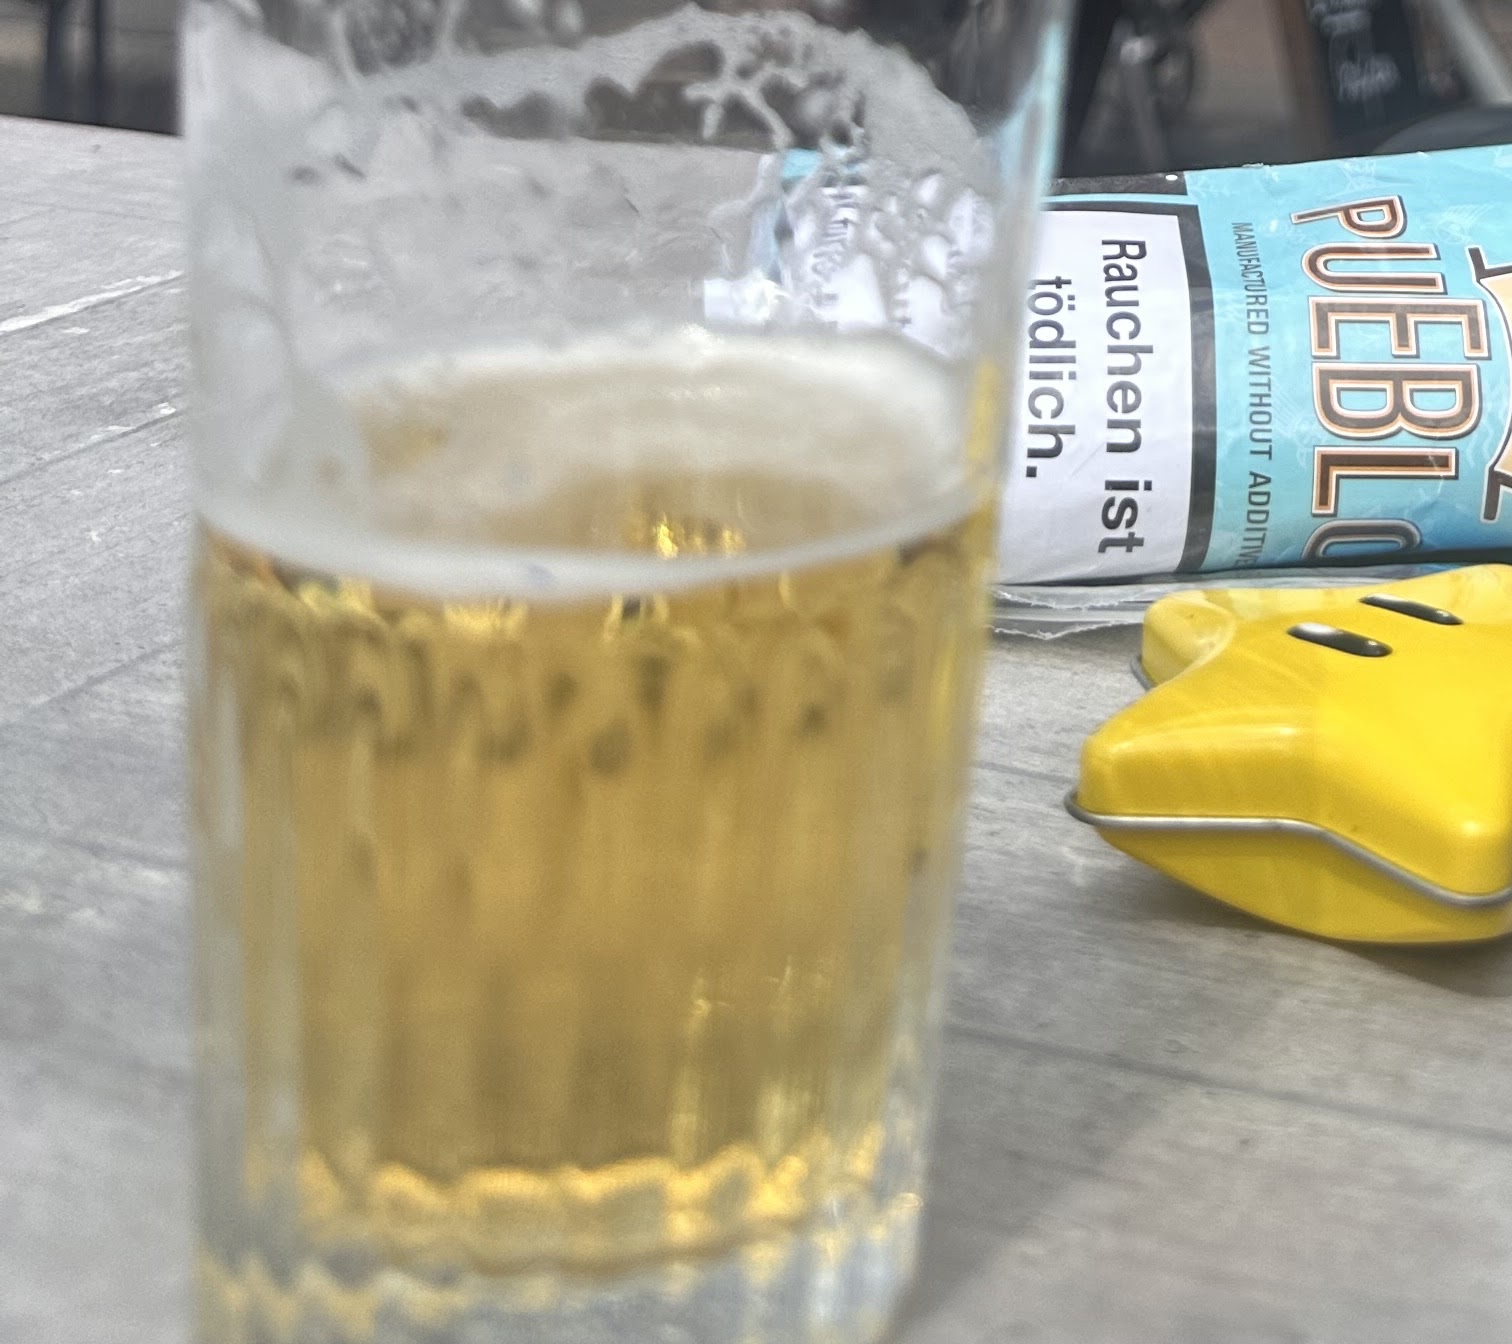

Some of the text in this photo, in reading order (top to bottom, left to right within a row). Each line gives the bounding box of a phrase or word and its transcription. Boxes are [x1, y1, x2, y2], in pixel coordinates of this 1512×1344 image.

[1025, 276, 1077, 480] tödlich.
[1231, 221, 1270, 335] MANUFACTURED
[1291, 194, 1493, 562] PUEBLO
[1098, 238, 1155, 555] Rauchen ist
[1247, 345, 1274, 462] WITHOUT
